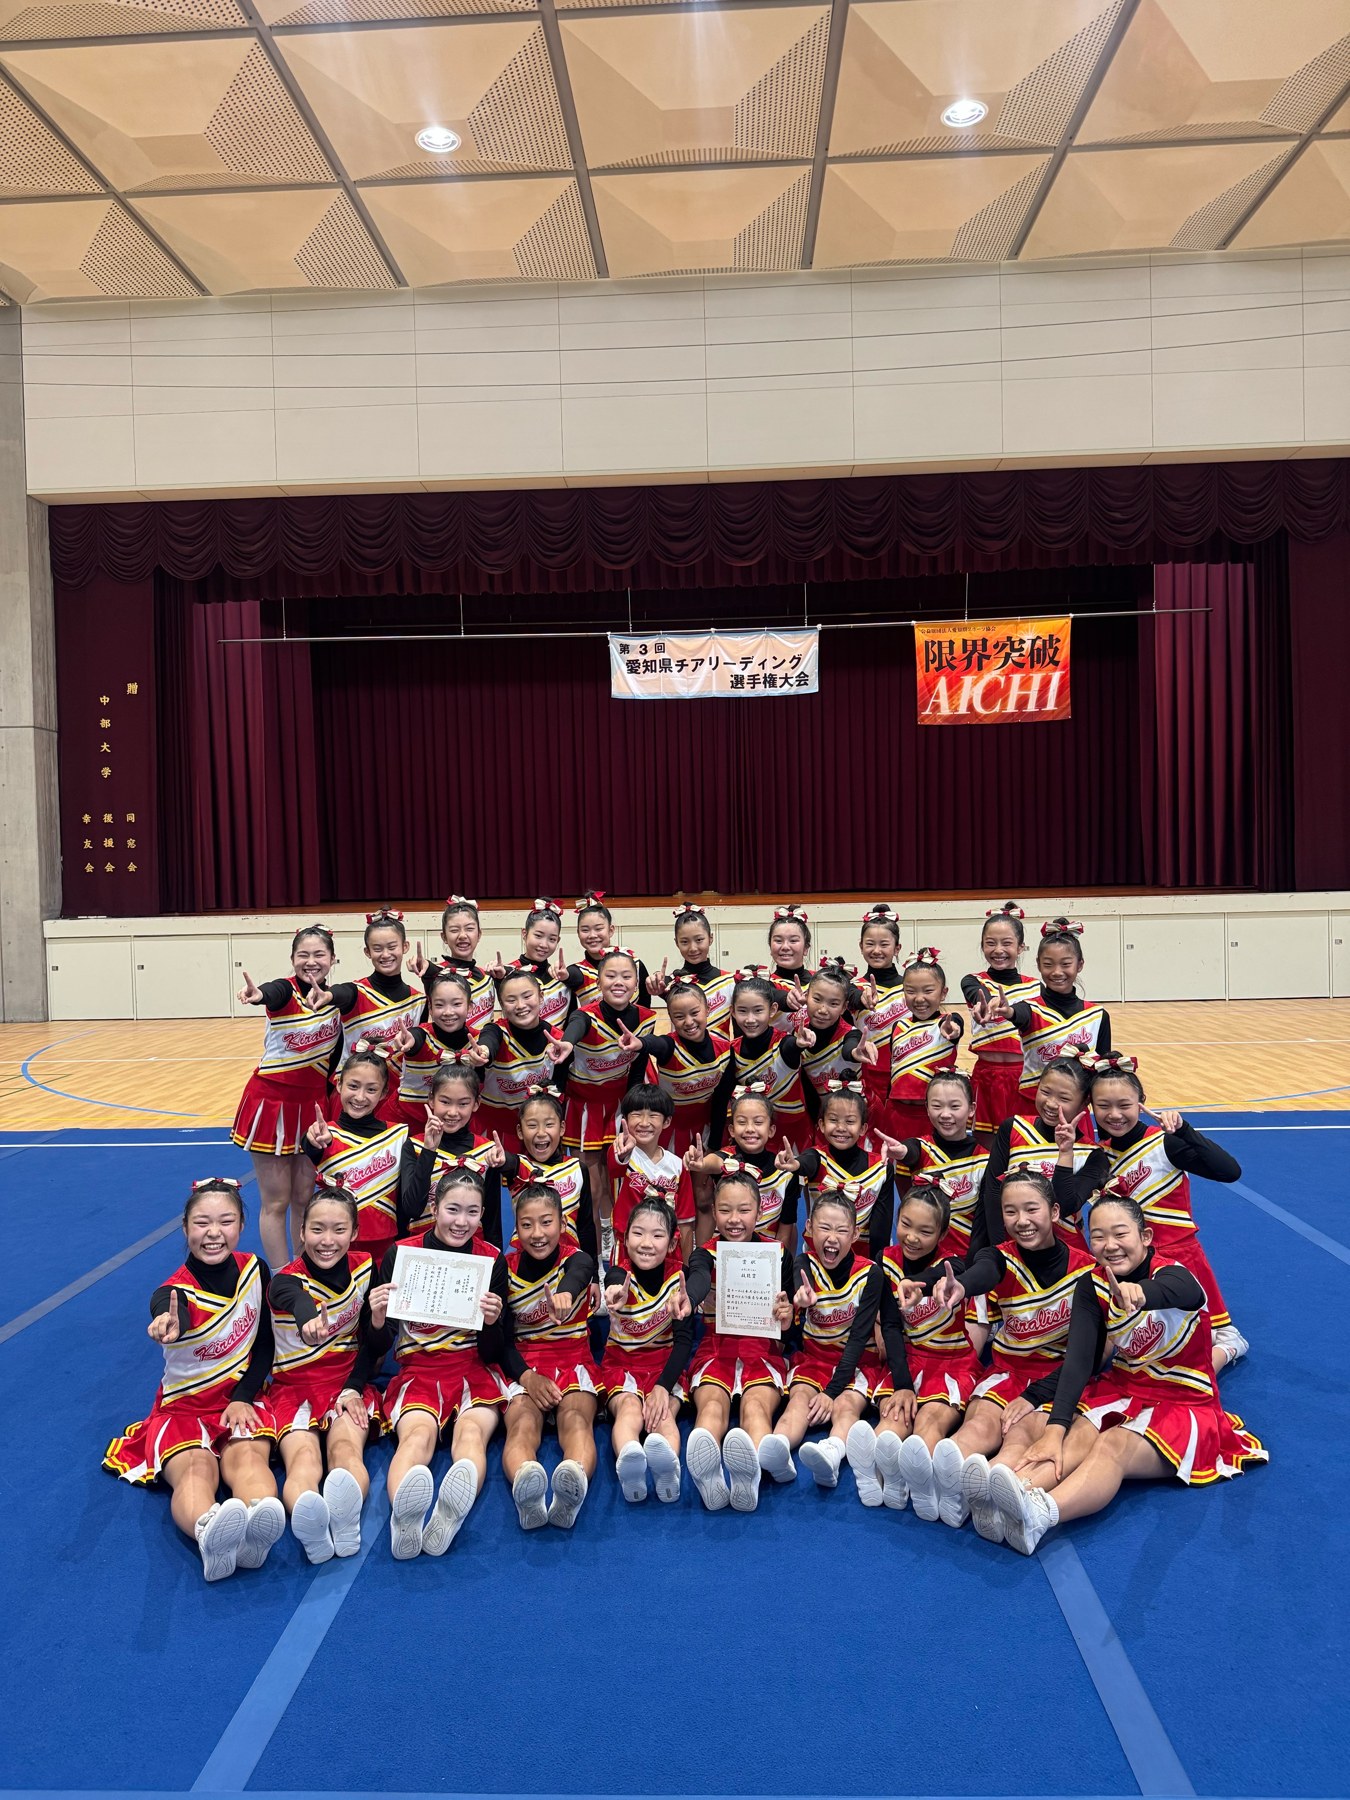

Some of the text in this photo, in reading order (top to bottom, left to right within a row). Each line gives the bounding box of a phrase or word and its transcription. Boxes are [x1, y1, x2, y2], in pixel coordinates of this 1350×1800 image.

[626, 654, 802, 674] 愛知県チアリーディング
[924, 634, 1062, 673] 限界突破
[730, 672, 809, 689] 選手権大会
[921, 671, 1065, 715] AICHI
[100, 696, 112, 778] 中部大学
[103, 813, 115, 873] 後援会
[282, 1018, 341, 1053] Kiralish
[193, 1302, 257, 1361] Kiralish
[808, 1302, 857, 1329] Kiralish
[1003, 1298, 1072, 1342] Kiralish
